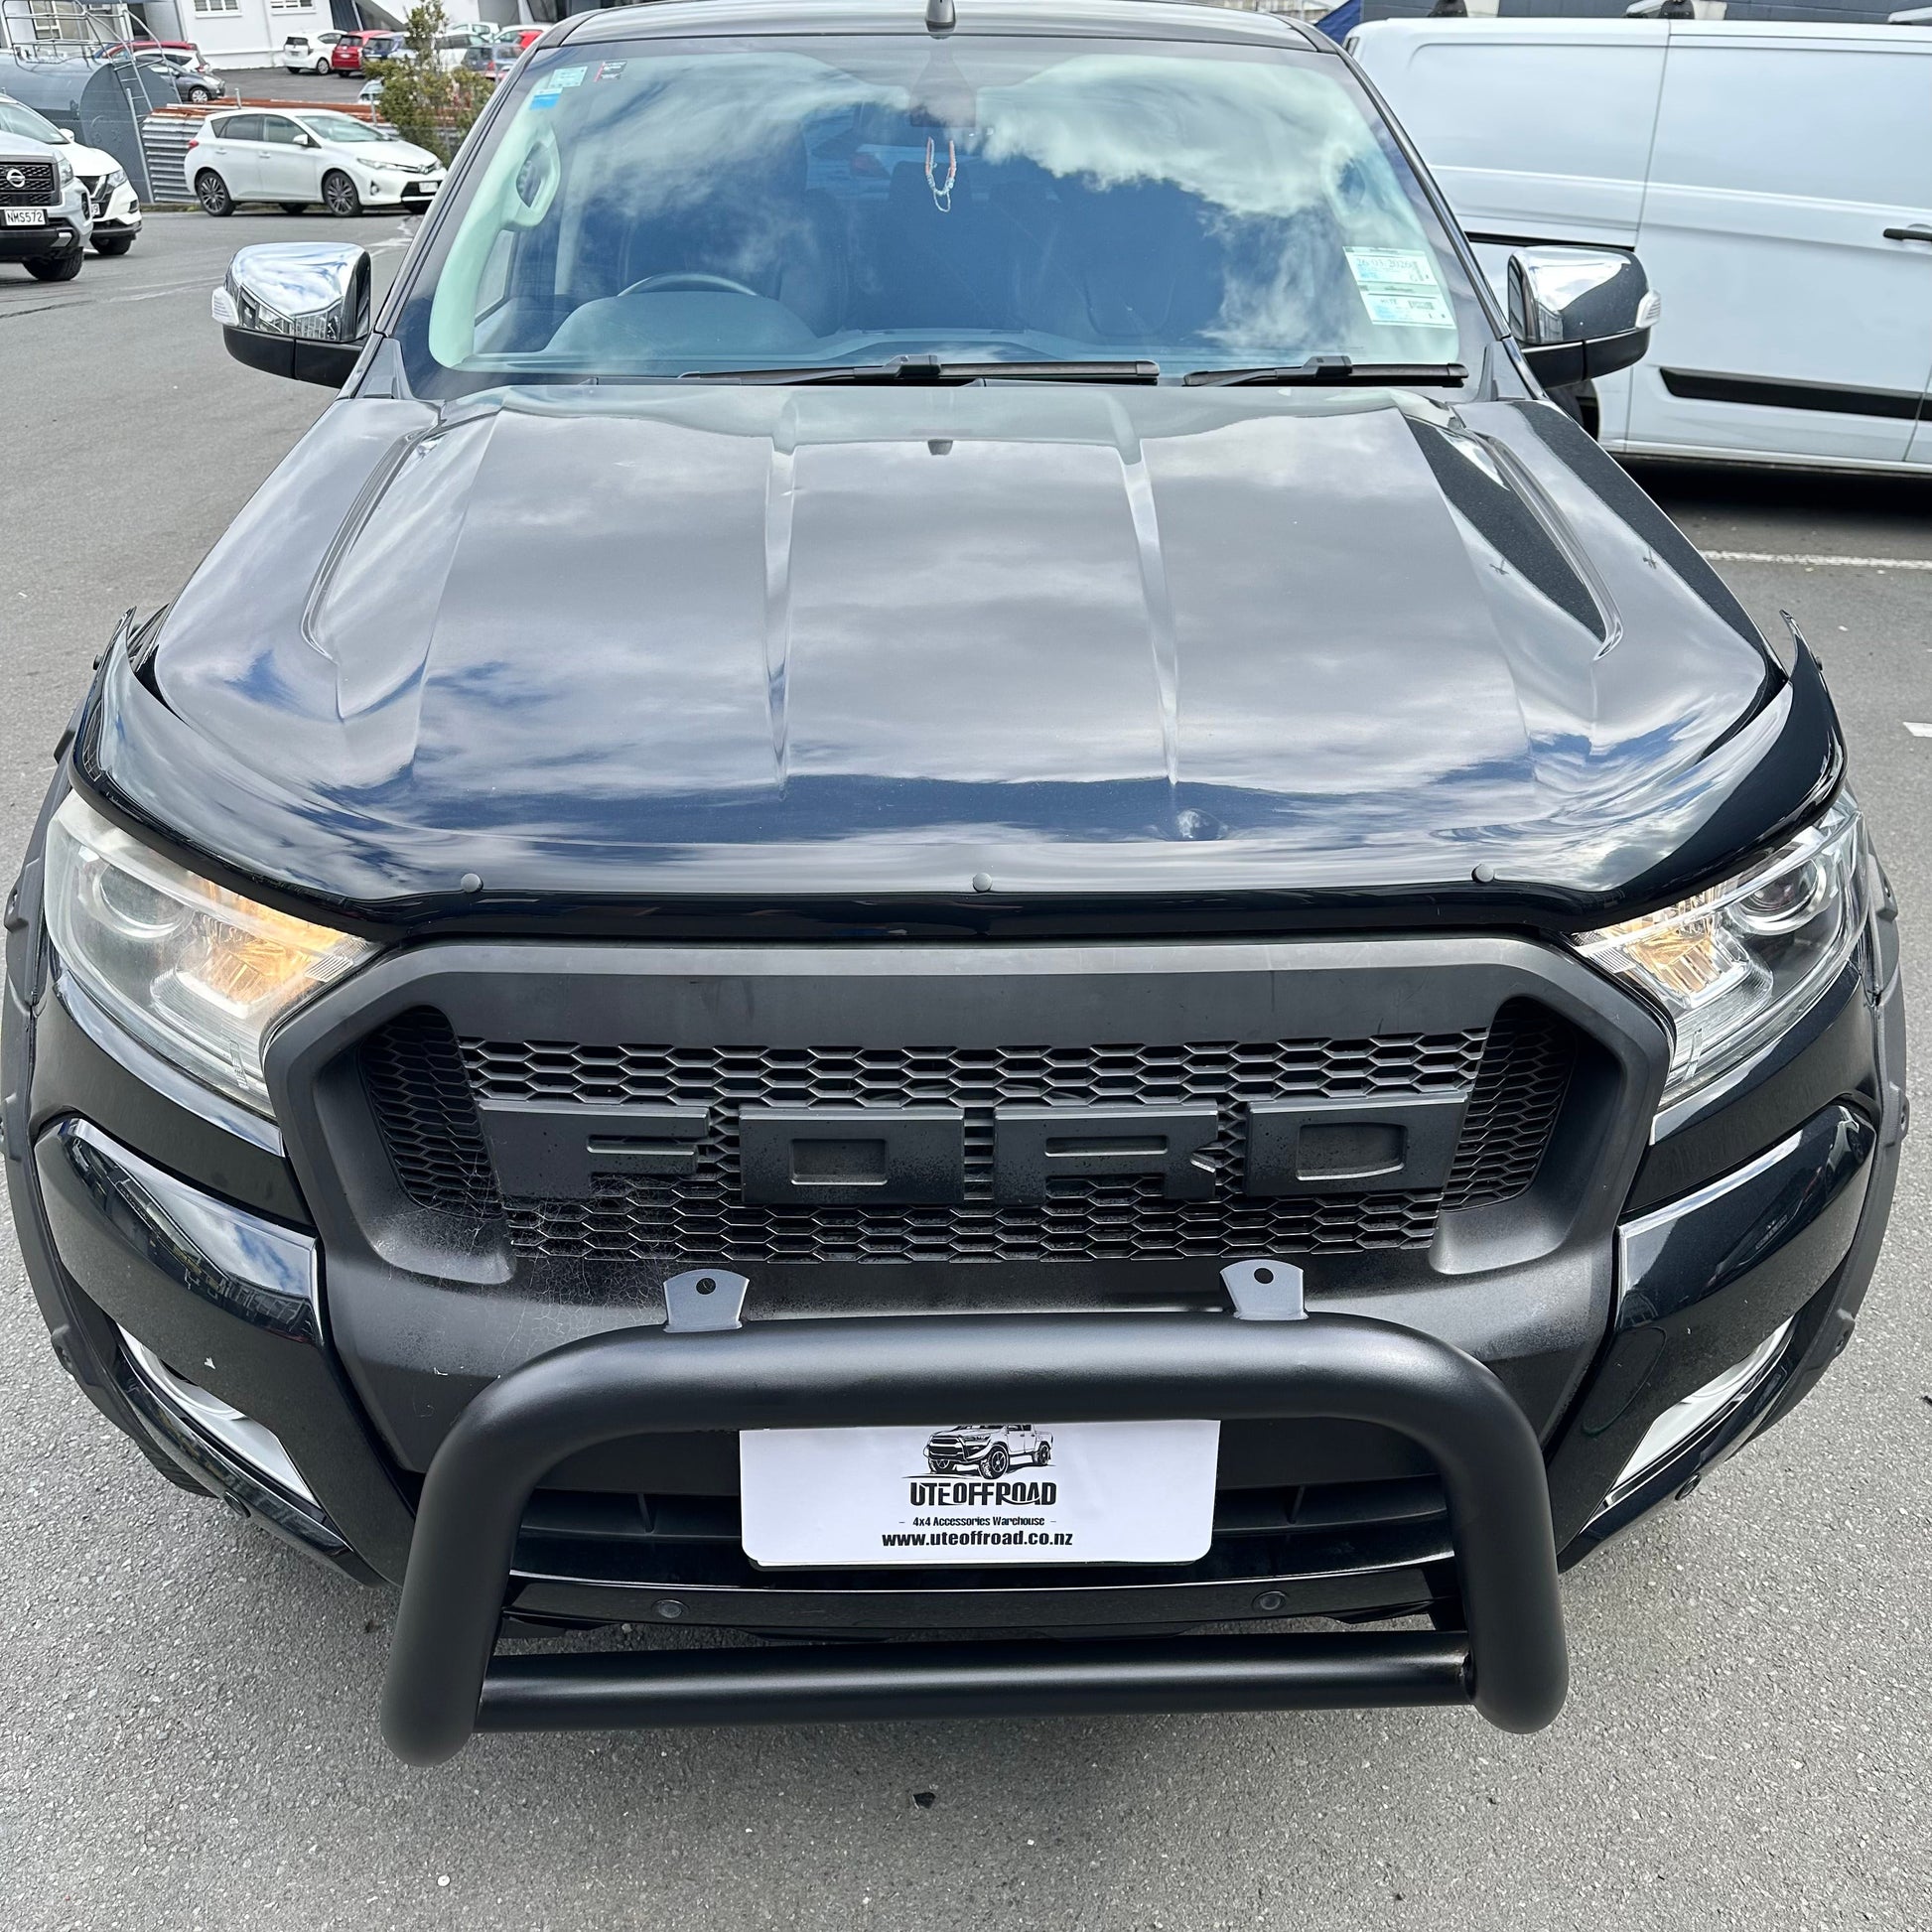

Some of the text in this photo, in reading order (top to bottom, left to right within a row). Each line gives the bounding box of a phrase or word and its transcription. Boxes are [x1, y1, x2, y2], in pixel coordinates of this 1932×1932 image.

[7, 211, 43, 223] NMS572
[477, 1091, 1469, 1205] FORD
[909, 1482, 1057, 1506] UTEOFFROAD
[912, 1516, 1045, 1527] 4x4 Accessories Warehouse
[882, 1531, 1073, 1547] www.uteoffroad.co.nz
